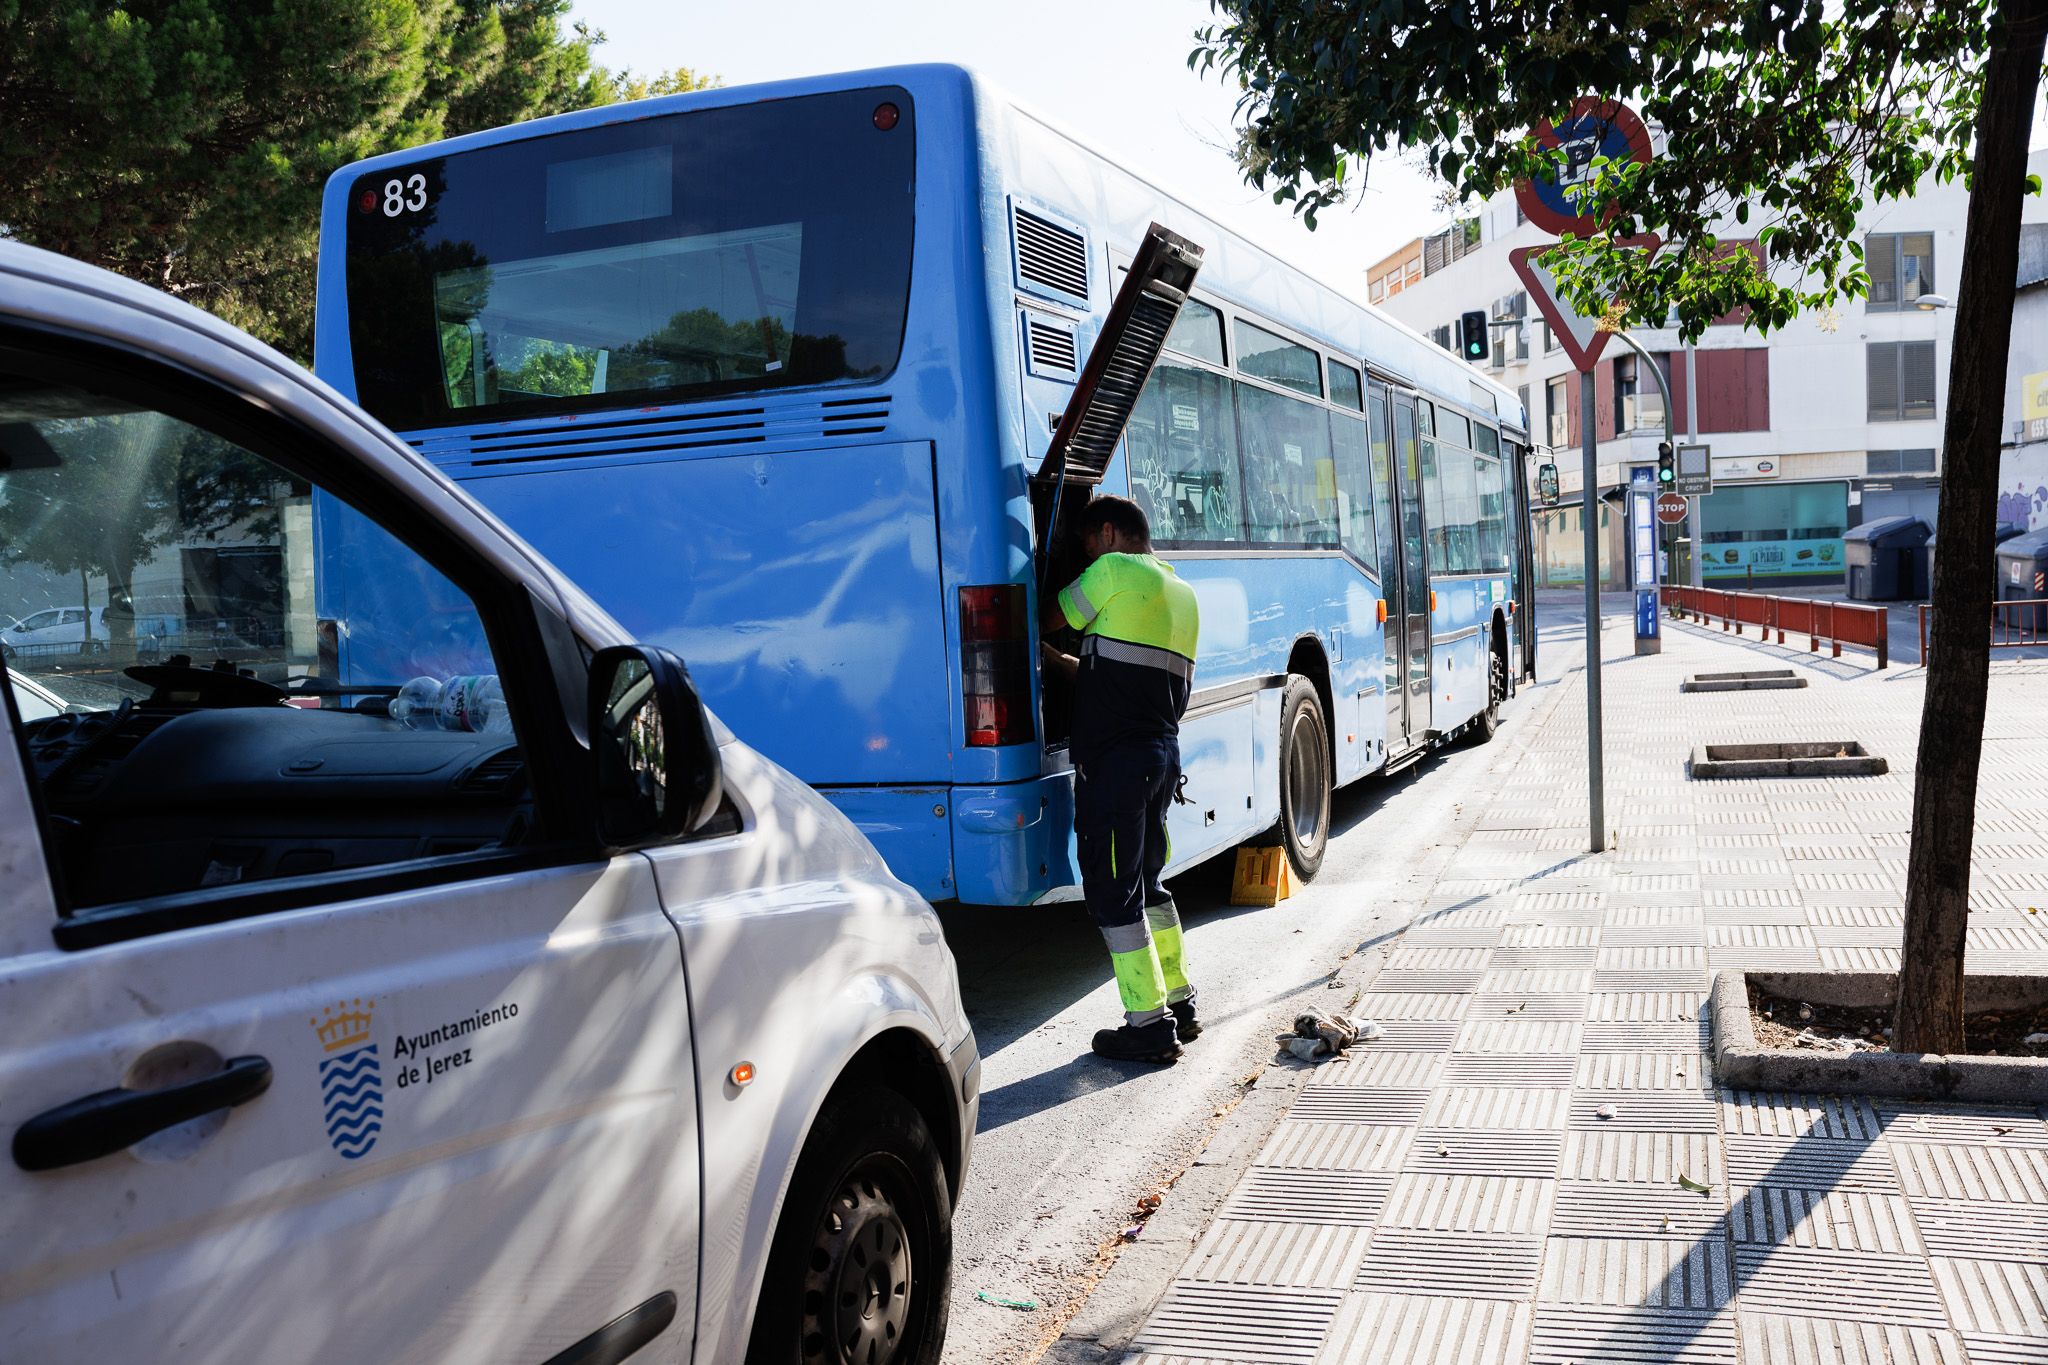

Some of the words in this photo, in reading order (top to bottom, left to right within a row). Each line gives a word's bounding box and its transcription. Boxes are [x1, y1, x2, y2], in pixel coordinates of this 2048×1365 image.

[383, 173, 427, 217] 83
[1658, 504, 1685, 513] STOP
[394, 1003, 518, 1060] Ayuntamiento
[397, 1066, 420, 1088] de
[426, 1048, 473, 1084] Jerez
